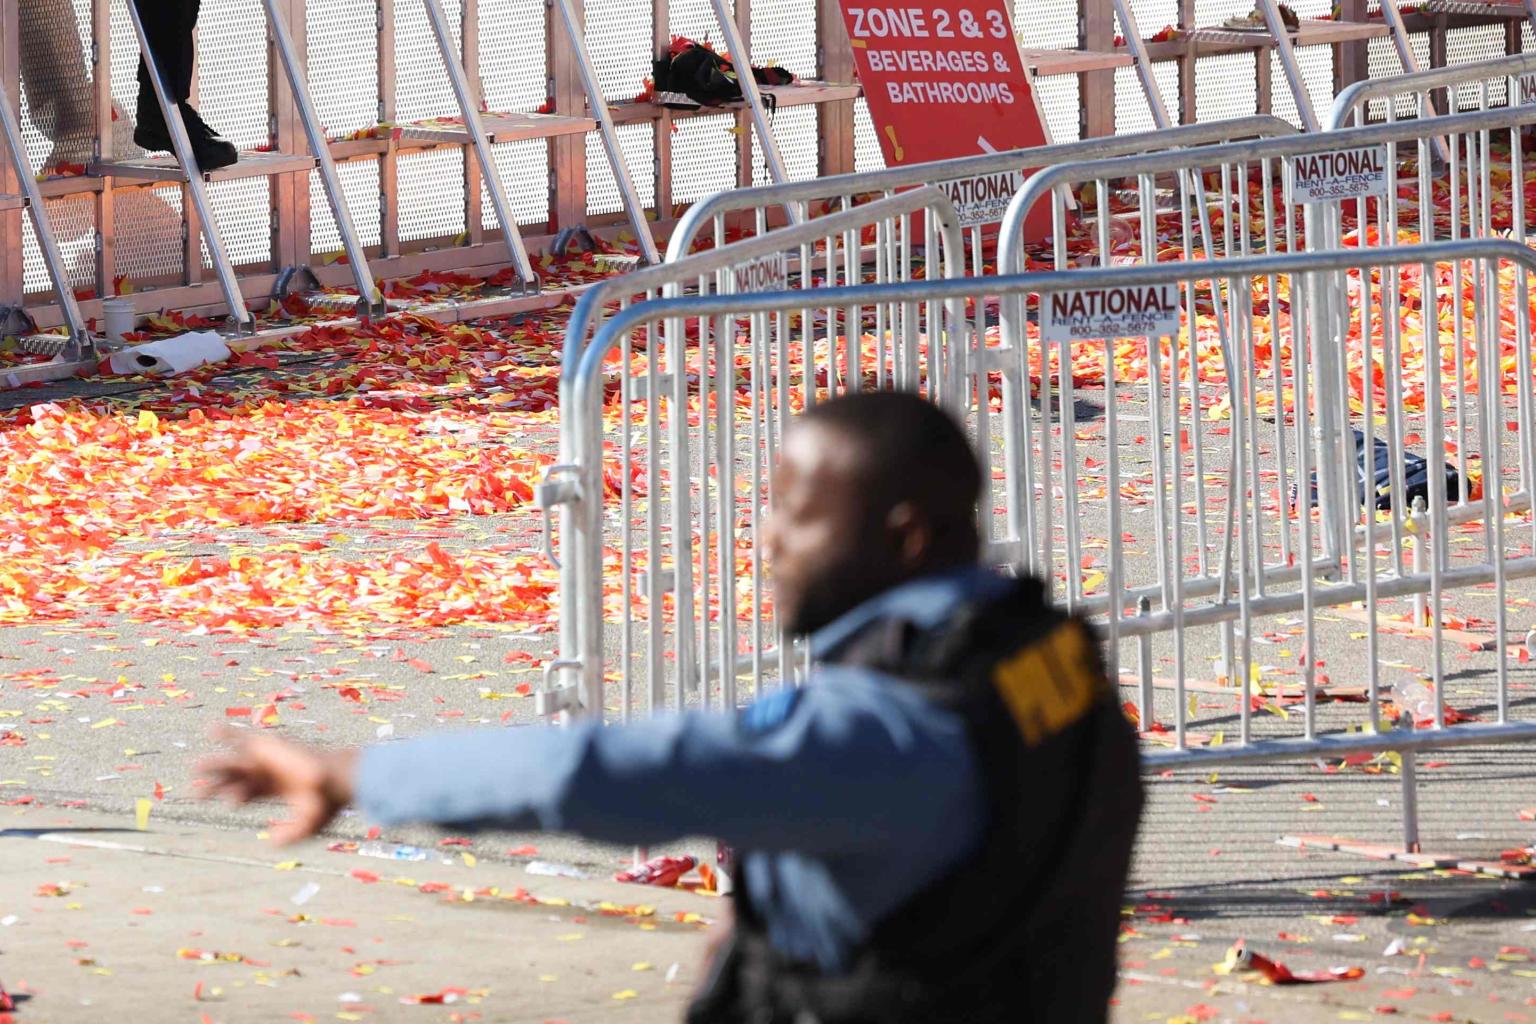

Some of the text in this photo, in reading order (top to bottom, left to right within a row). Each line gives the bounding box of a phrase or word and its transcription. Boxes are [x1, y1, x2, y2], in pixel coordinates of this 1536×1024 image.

[848, 8, 1008, 39] ZONE 2 & 3
[866, 50, 1011, 73] BEVERAGES &
[886, 82, 1014, 104] BATHROOMS
[1295, 149, 1384, 181] NATIONAL
[1295, 172, 1385, 189] RENT-A-FENCE
[1309, 182, 1370, 197] 800-352-5675
[953, 197, 1012, 213] NT-A-FENC
[959, 206, 1007, 222] 0-352-567
[1051, 286, 1175, 318] NATIONAL
[1051, 312, 1174, 327] RENT-A-FENCE
[1069, 322, 1156, 336] 800-352-5675
